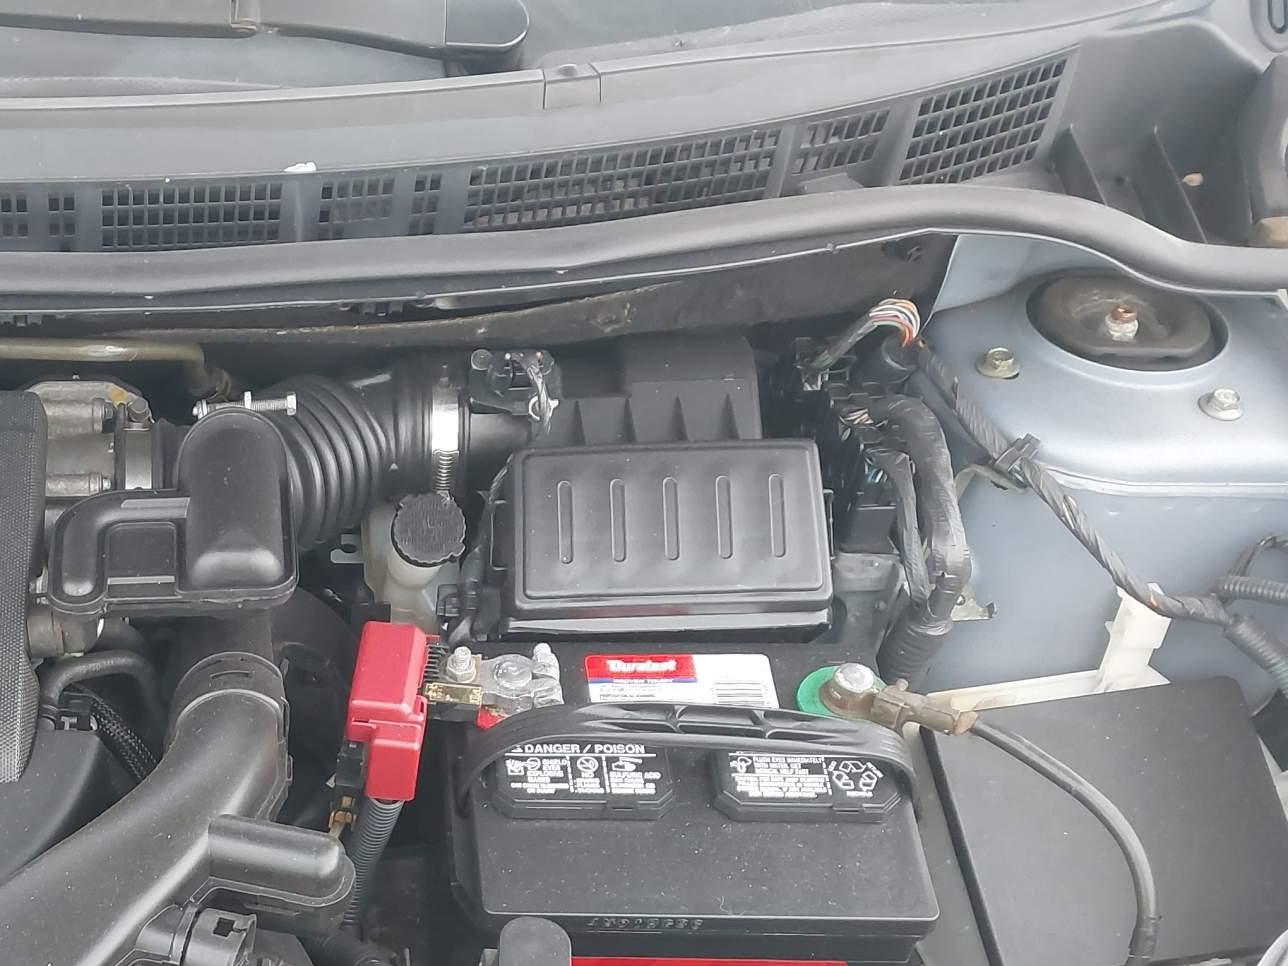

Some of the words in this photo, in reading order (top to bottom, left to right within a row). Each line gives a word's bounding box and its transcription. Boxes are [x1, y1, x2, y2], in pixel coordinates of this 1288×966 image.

[524, 744, 580, 753] DANGER
[583, 745, 591, 753] /
[595, 745, 645, 754] POISON
